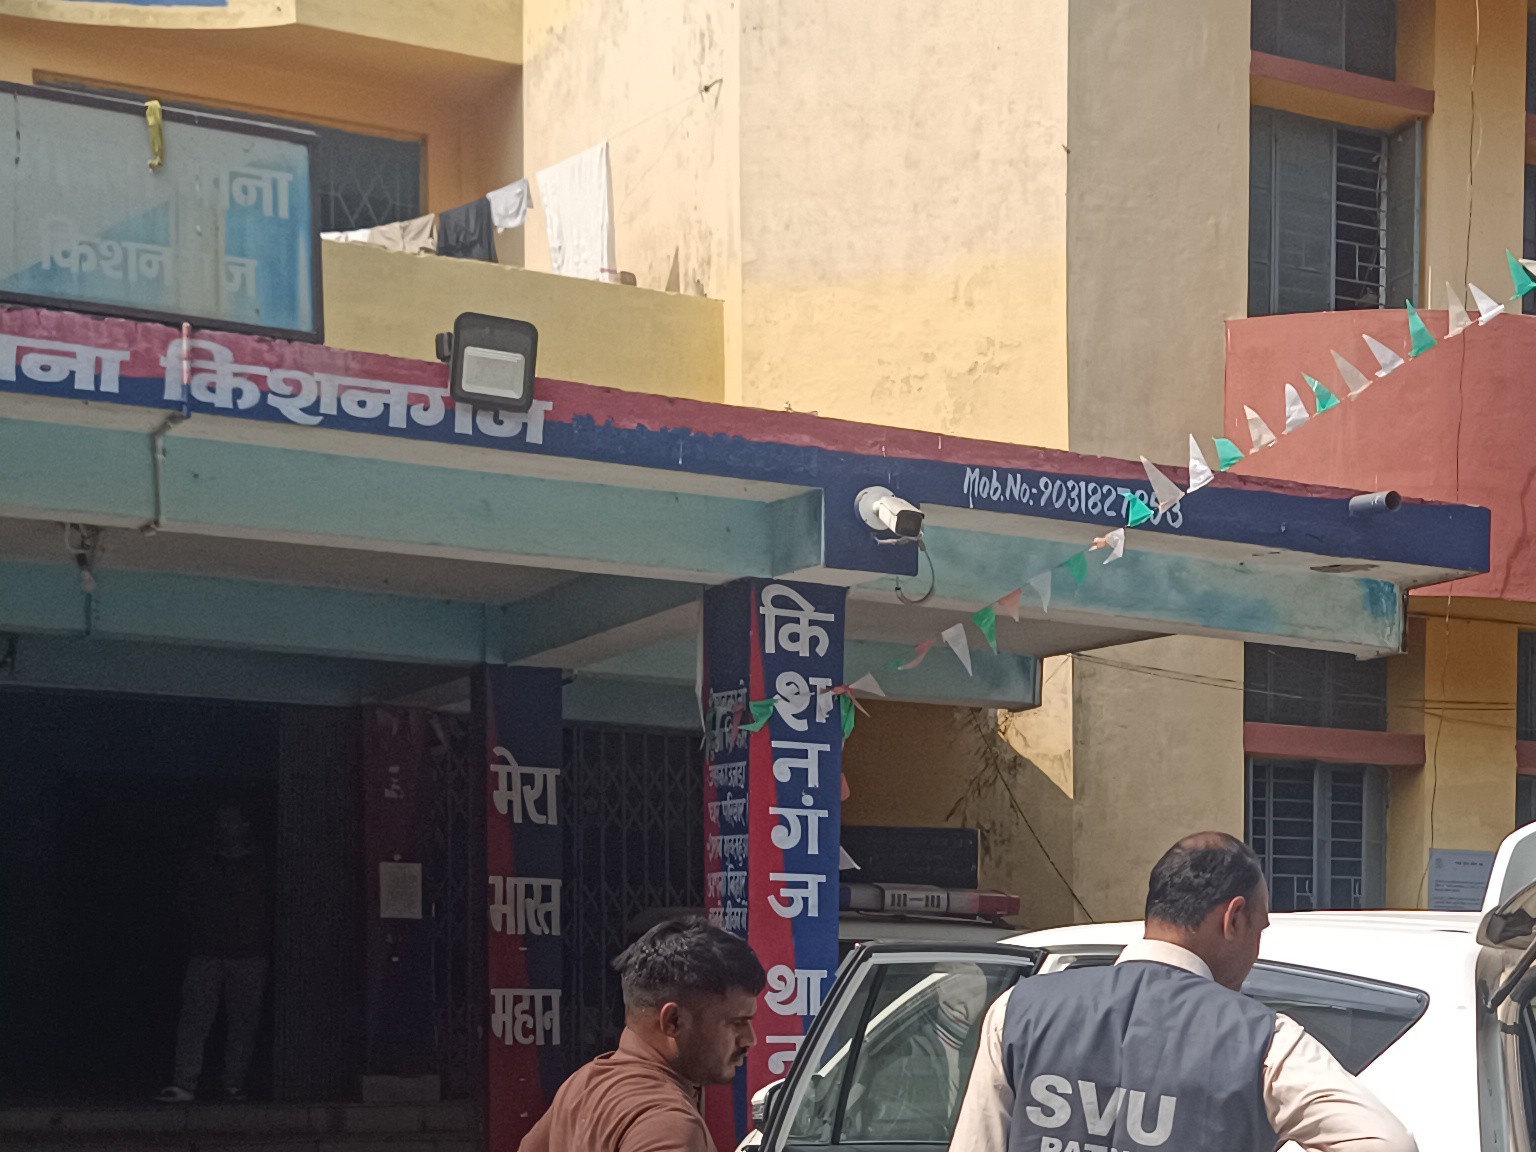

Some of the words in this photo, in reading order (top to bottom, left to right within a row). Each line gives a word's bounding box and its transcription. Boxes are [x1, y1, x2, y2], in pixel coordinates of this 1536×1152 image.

[490, 746, 561, 826] मेरा
[488, 875, 563, 936] भारत
[490, 988, 562, 1046] महान
[1025, 1074, 1177, 1147] SVU
